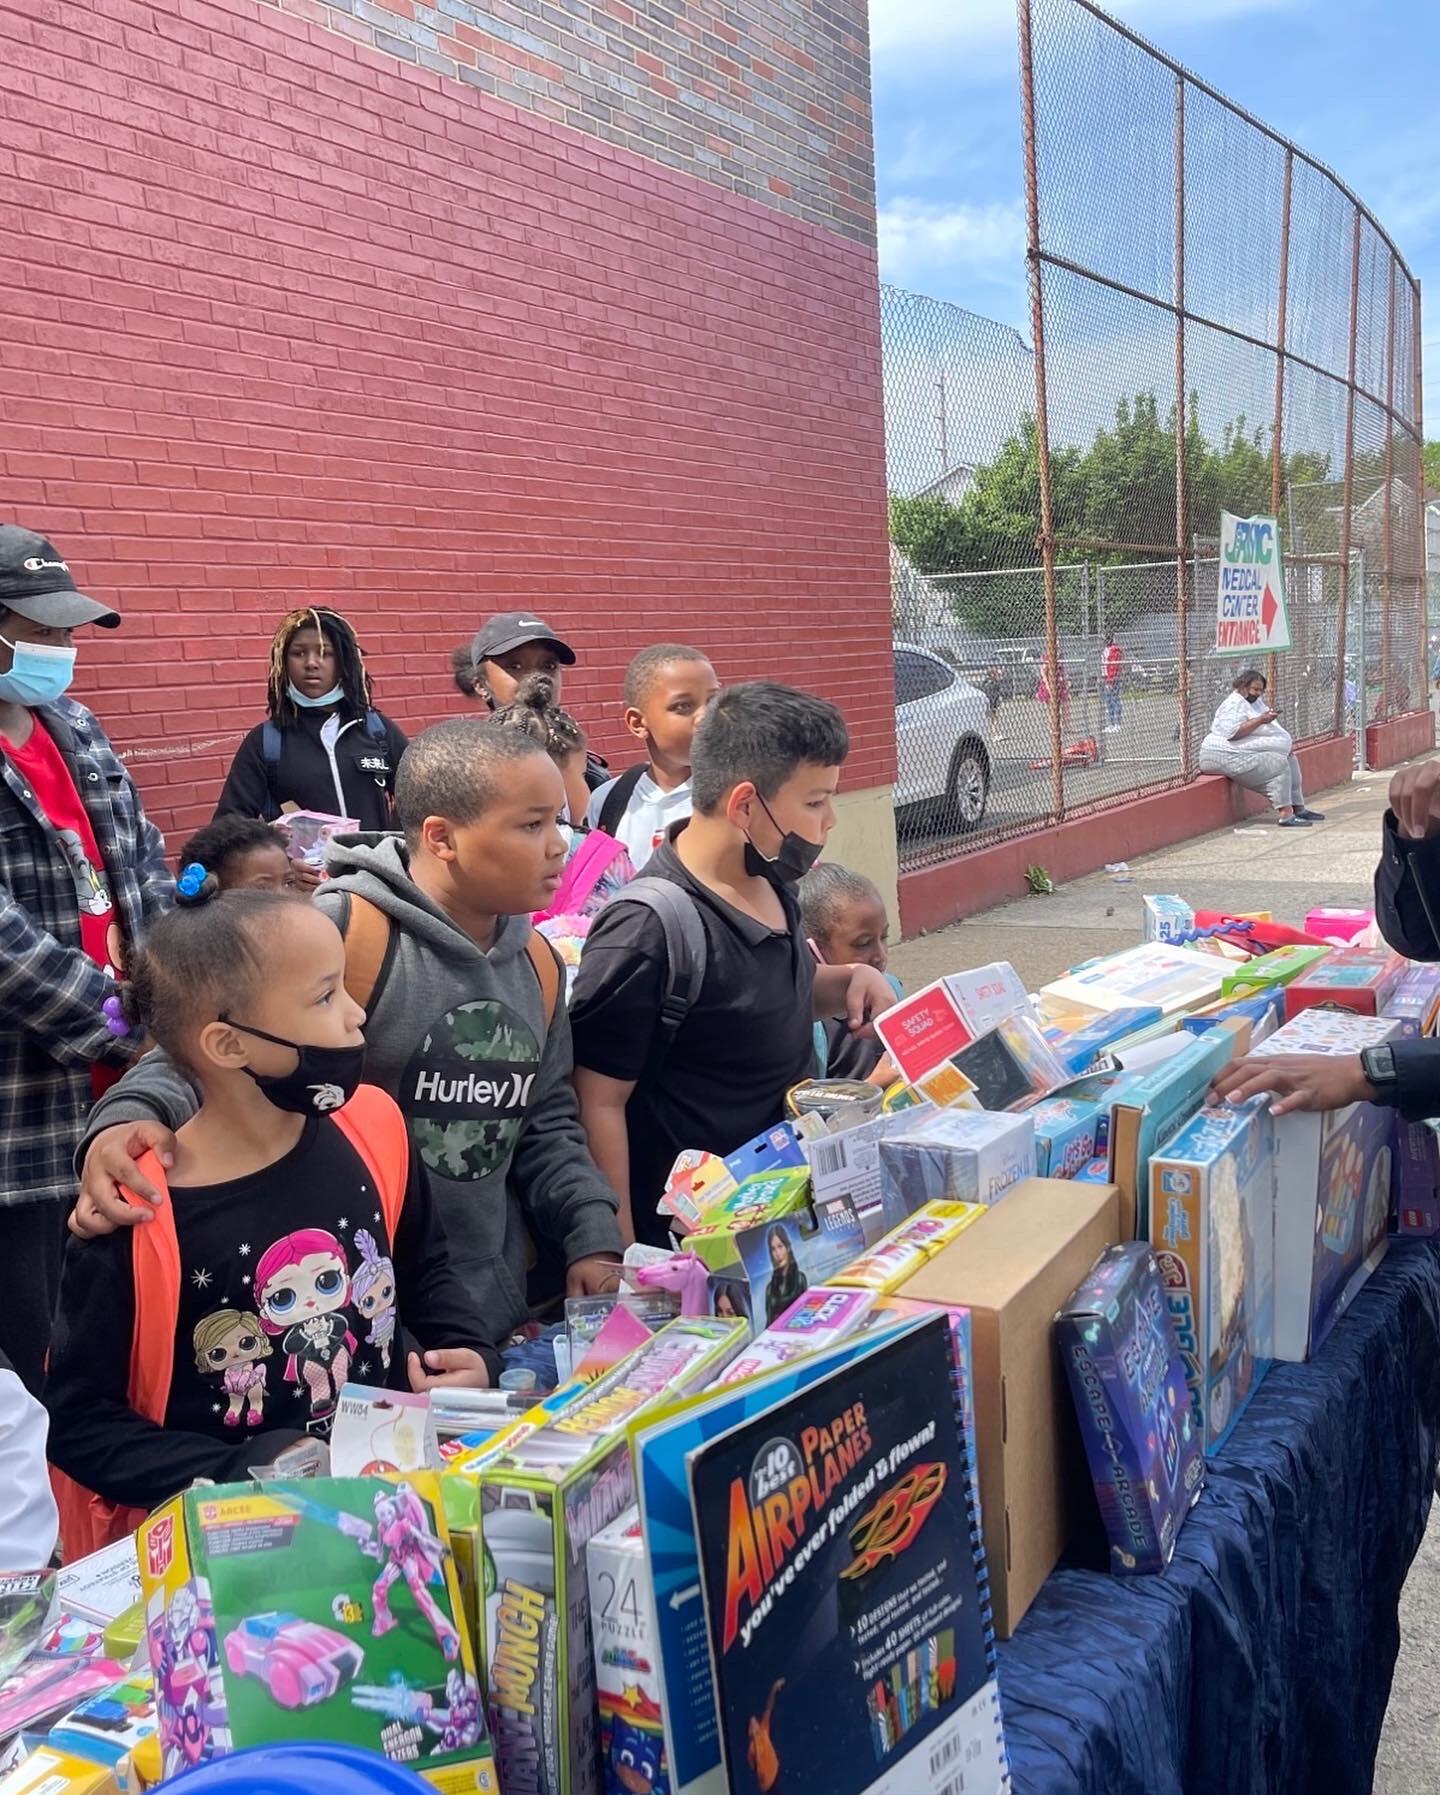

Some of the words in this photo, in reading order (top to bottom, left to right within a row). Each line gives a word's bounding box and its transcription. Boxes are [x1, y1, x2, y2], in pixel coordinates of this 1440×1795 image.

[901, 1008, 930, 1030] SAFETY
[414, 1071, 510, 1107] Hurley
[341, 1400, 369, 1416] WW84
[801, 1401, 868, 1465] PAPER
[1072, 1345, 1113, 1431] ESCAPE
[1112, 1466, 1149, 1548] ARCADE
[757, 1460, 796, 1501] best
[767, 1444, 789, 1478] 10
[723, 1424, 873, 1654] AIRPLANES
[740, 1567, 796, 1648] you've
[794, 1521, 830, 1573] ever
[826, 1468, 877, 1536] folded
[887, 1420, 937, 1474] flown!
[598, 1570, 644, 1627] 24
[490, 1577, 545, 1715] MUNCH
[601, 1621, 645, 1641] PUZZLE
